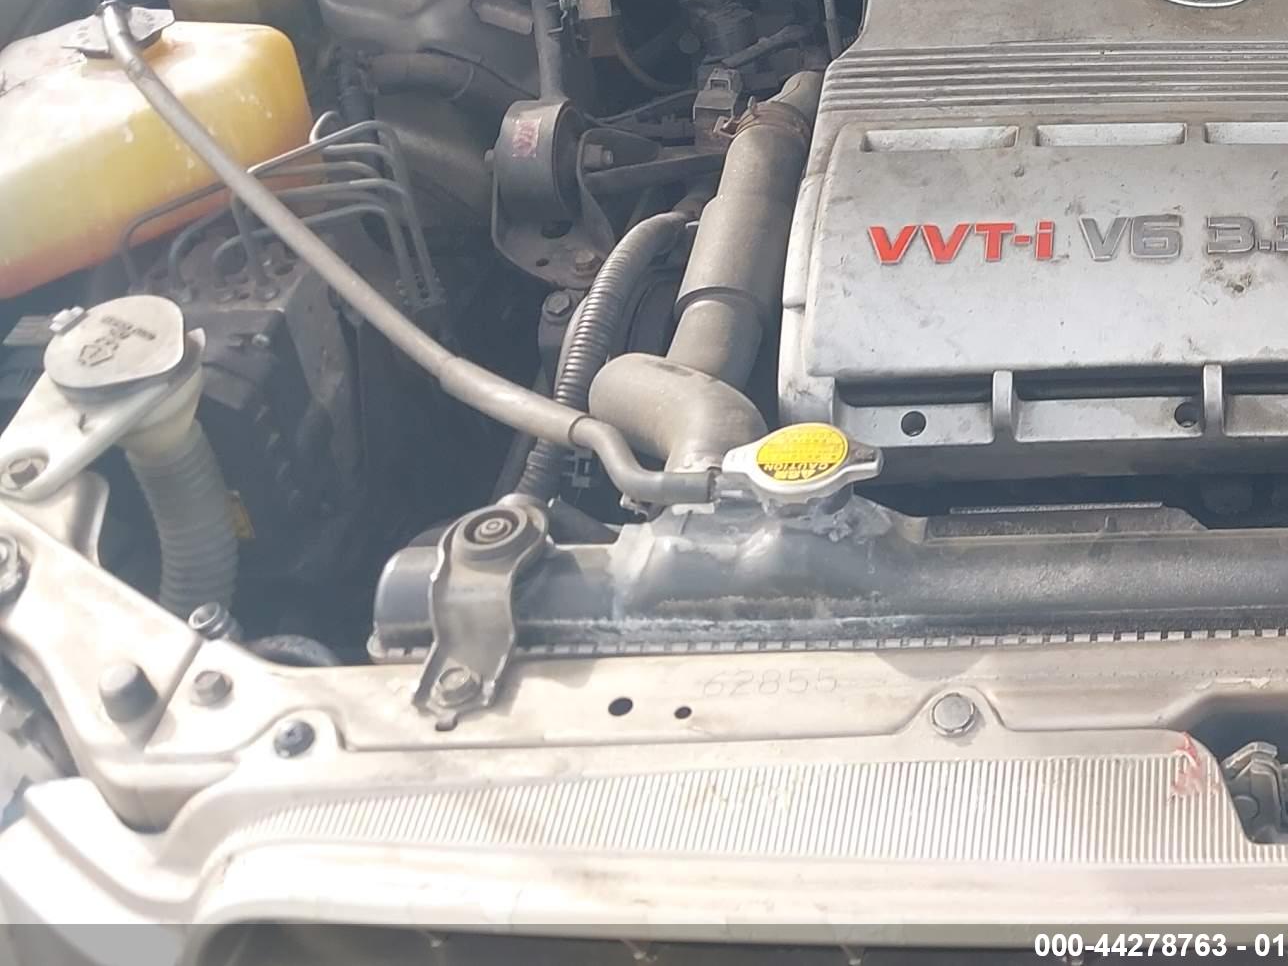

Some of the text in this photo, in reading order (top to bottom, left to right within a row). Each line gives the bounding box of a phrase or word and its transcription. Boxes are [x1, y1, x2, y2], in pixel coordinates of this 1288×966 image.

[868, 219, 1054, 265] VVT-i
[1079, 214, 1182, 262] V6
[763, 462, 829, 472] CAUTION
[703, 667, 838, 698] 62855
